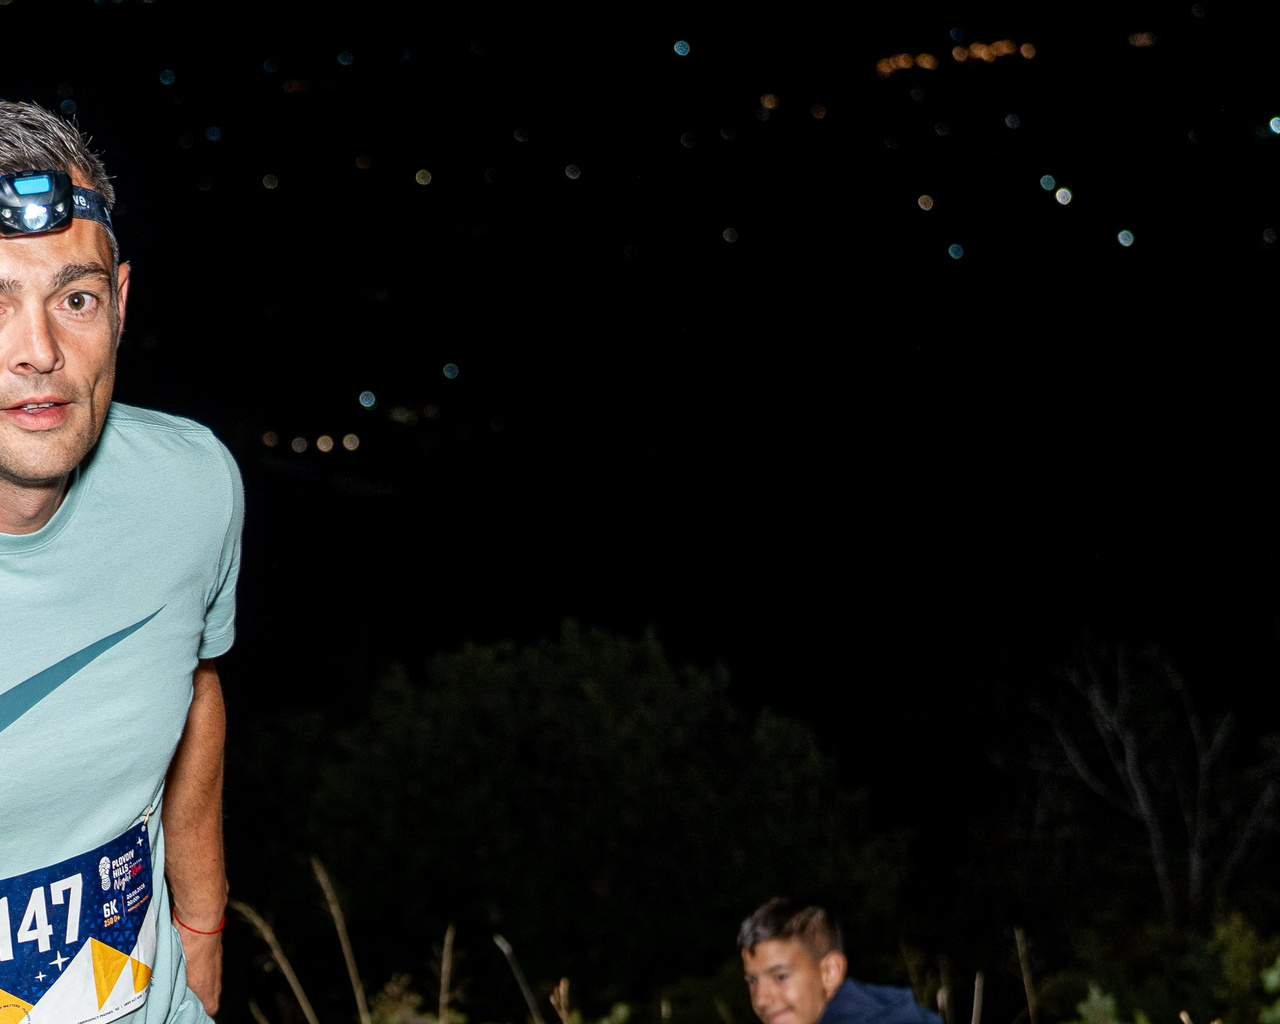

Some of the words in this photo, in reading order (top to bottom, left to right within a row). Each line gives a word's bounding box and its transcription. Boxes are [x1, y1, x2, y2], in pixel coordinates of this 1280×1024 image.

[111, 849, 134, 869] PLOVDIV
[112, 863, 129, 878] HILLS
[102, 899, 119, 918] 6K
